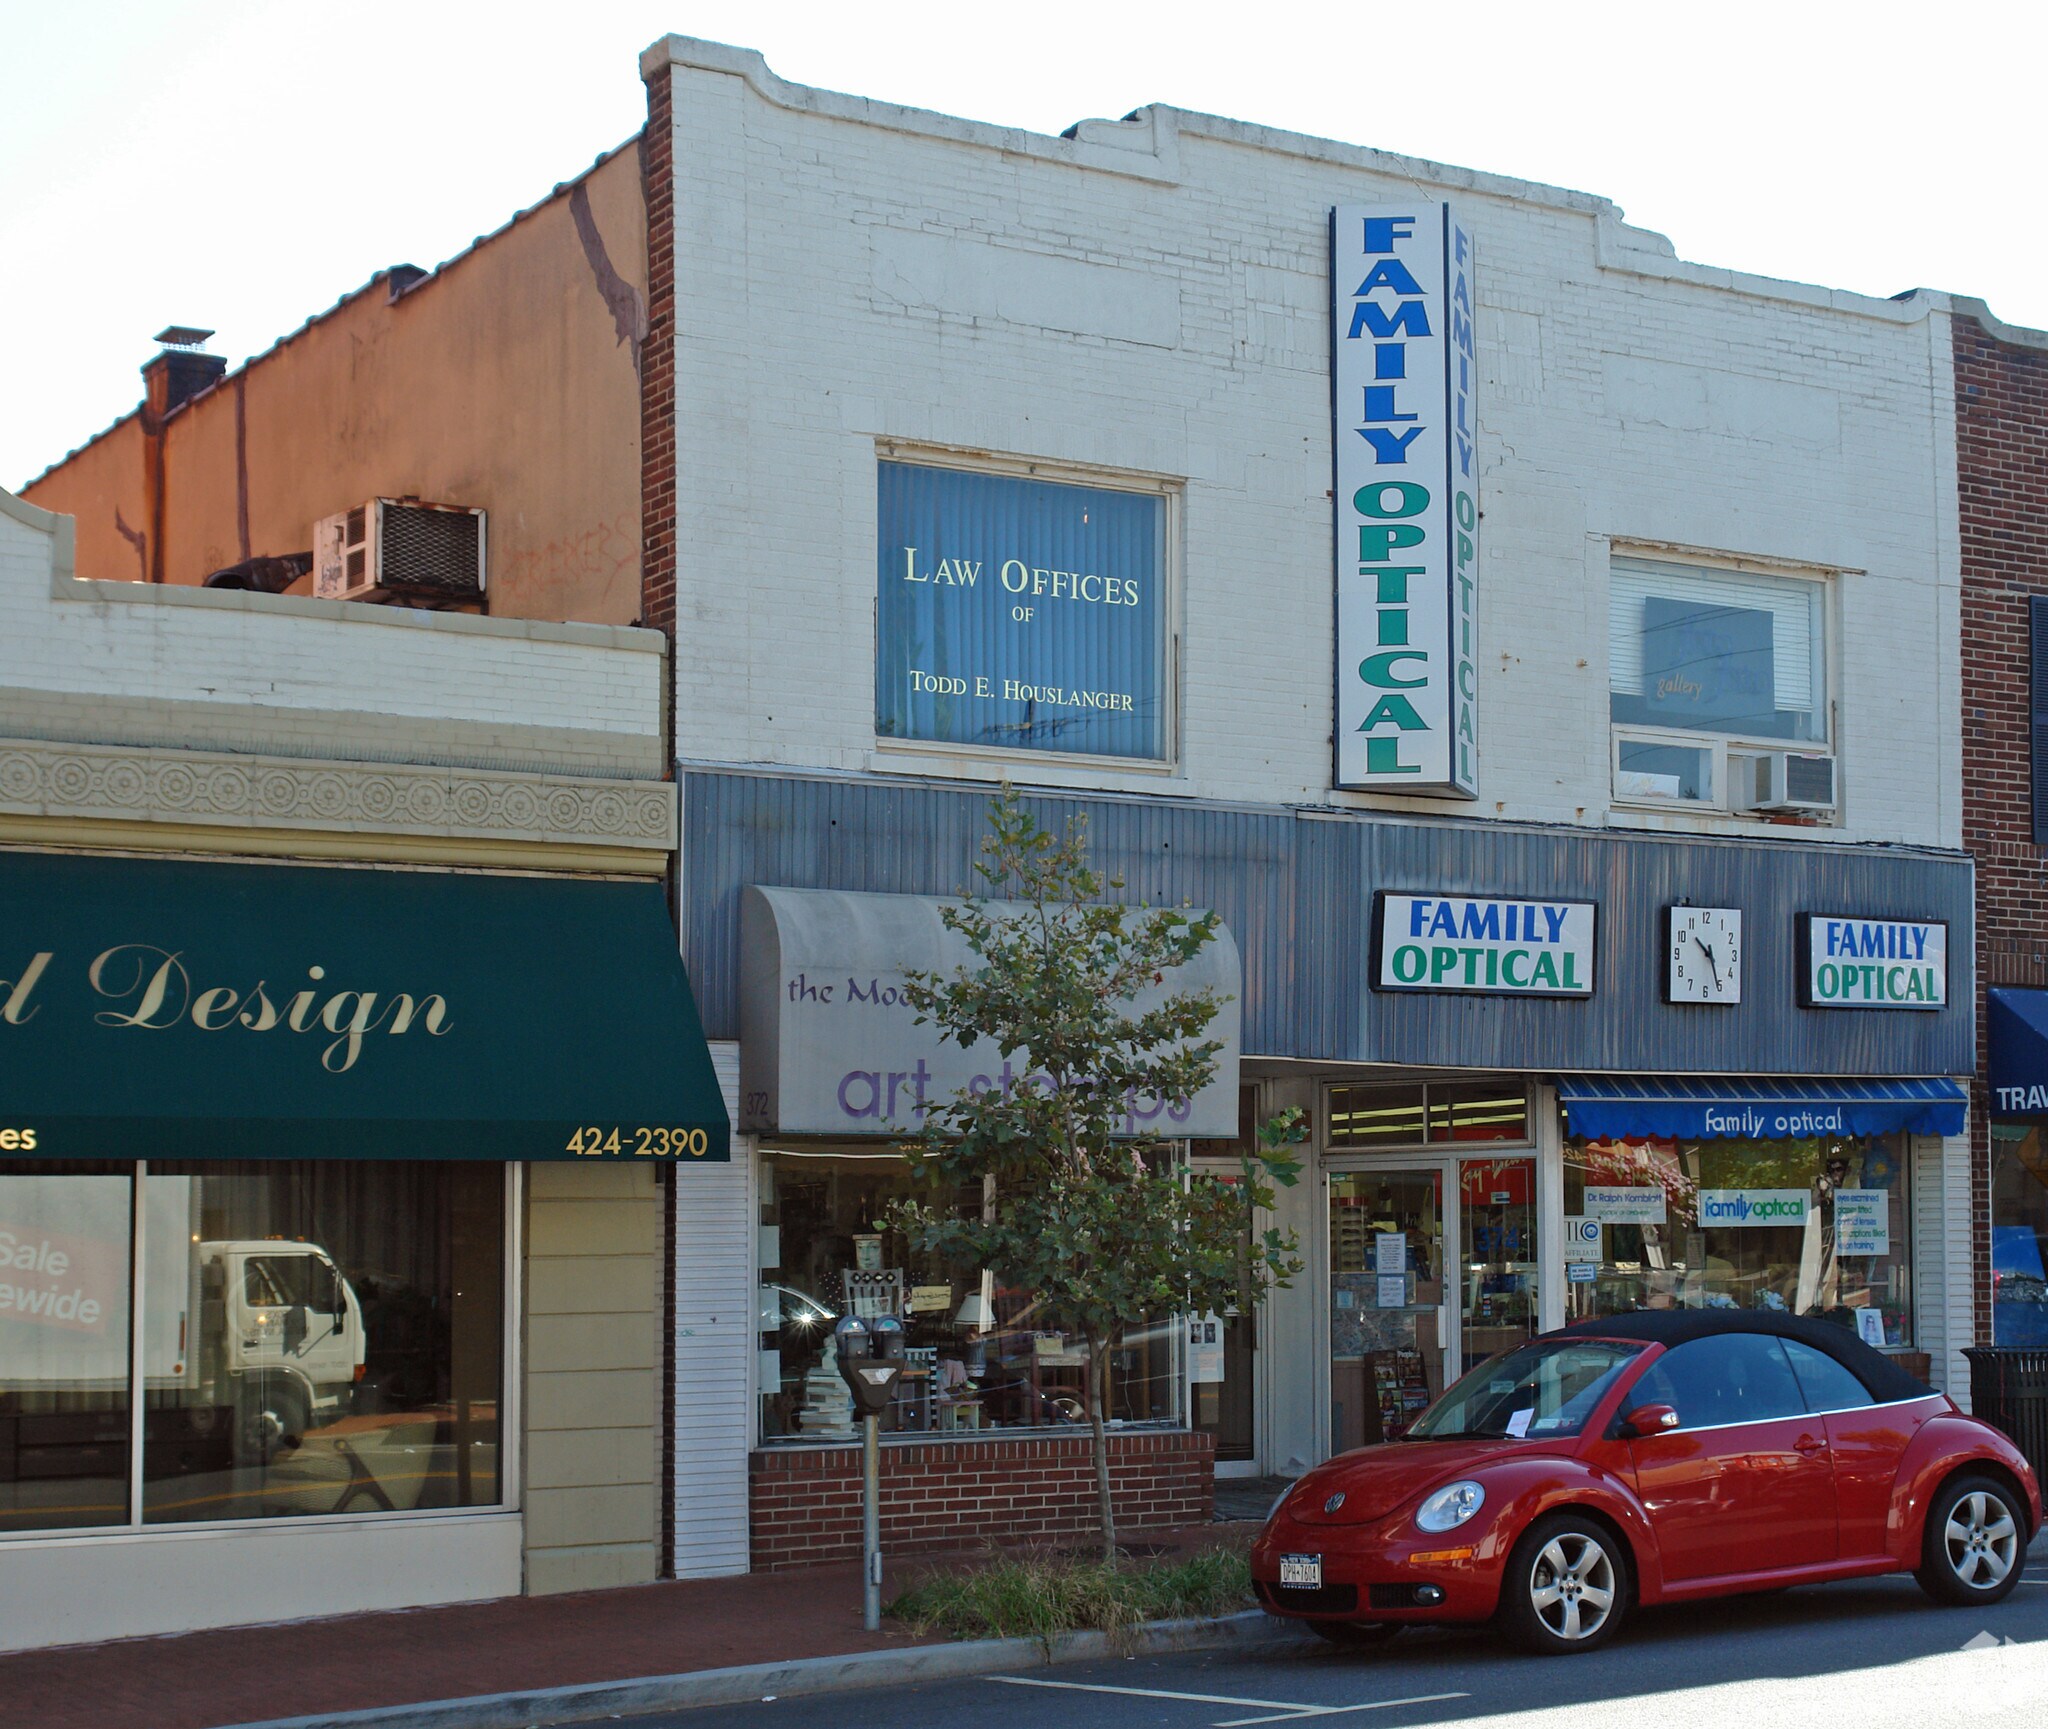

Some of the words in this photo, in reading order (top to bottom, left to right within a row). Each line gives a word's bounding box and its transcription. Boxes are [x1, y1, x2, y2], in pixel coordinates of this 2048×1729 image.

[1347, 217, 1434, 464] FAMILY
[1453, 223, 1474, 479] FAMILY
[904, 547, 982, 587] LAW
[1001, 560, 1139, 606] OFFICES
[1012, 606, 1034, 622] OF
[1353, 481, 1432, 775] OPTICAL
[1455, 490, 1475, 785] OPTICAL
[910, 670, 966, 696] TODD
[975, 677, 995, 698] E.
[1004, 680, 1133, 711] HOUSLANGER
[1657, 672, 1703, 701] gallery
[1410, 900, 1568, 943] FAMILY
[1689, 917, 1695, 930] 11
[1702, 912, 1711, 924] 12
[1720, 919, 1724, 931] 1
[1678, 930, 1686, 943] 10
[1728, 932, 1734, 945] 2
[1827, 922, 1928, 960] FAMILY
[1392, 945, 1582, 989] OPTICAL
[1674, 948, 1680, 960] 9
[1731, 950, 1737, 962] 3
[1678, 965, 1684, 978] 8
[1688, 978, 1693, 991] 7
[1728, 967, 1733, 979] 4
[1817, 963, 1939, 1001] OPTICAL
[787, 973, 834, 1004] the
[1703, 986, 1708, 998] 6
[89, 944, 455, 1073] Design
[837, 1058, 932, 1119] art
[746, 1091, 769, 1116] 372
[1706, 1106, 1765, 1138] family
[1775, 1106, 1842, 1135] optical
[565, 1126, 709, 1157] 424-2390
[1599, 1193, 1622, 1203] Ralph
[0, 1231, 69, 1277] Sale
[1478, 1227, 1520, 1252] 374
[1564, 1248, 1599, 1257] AFFILIATE
